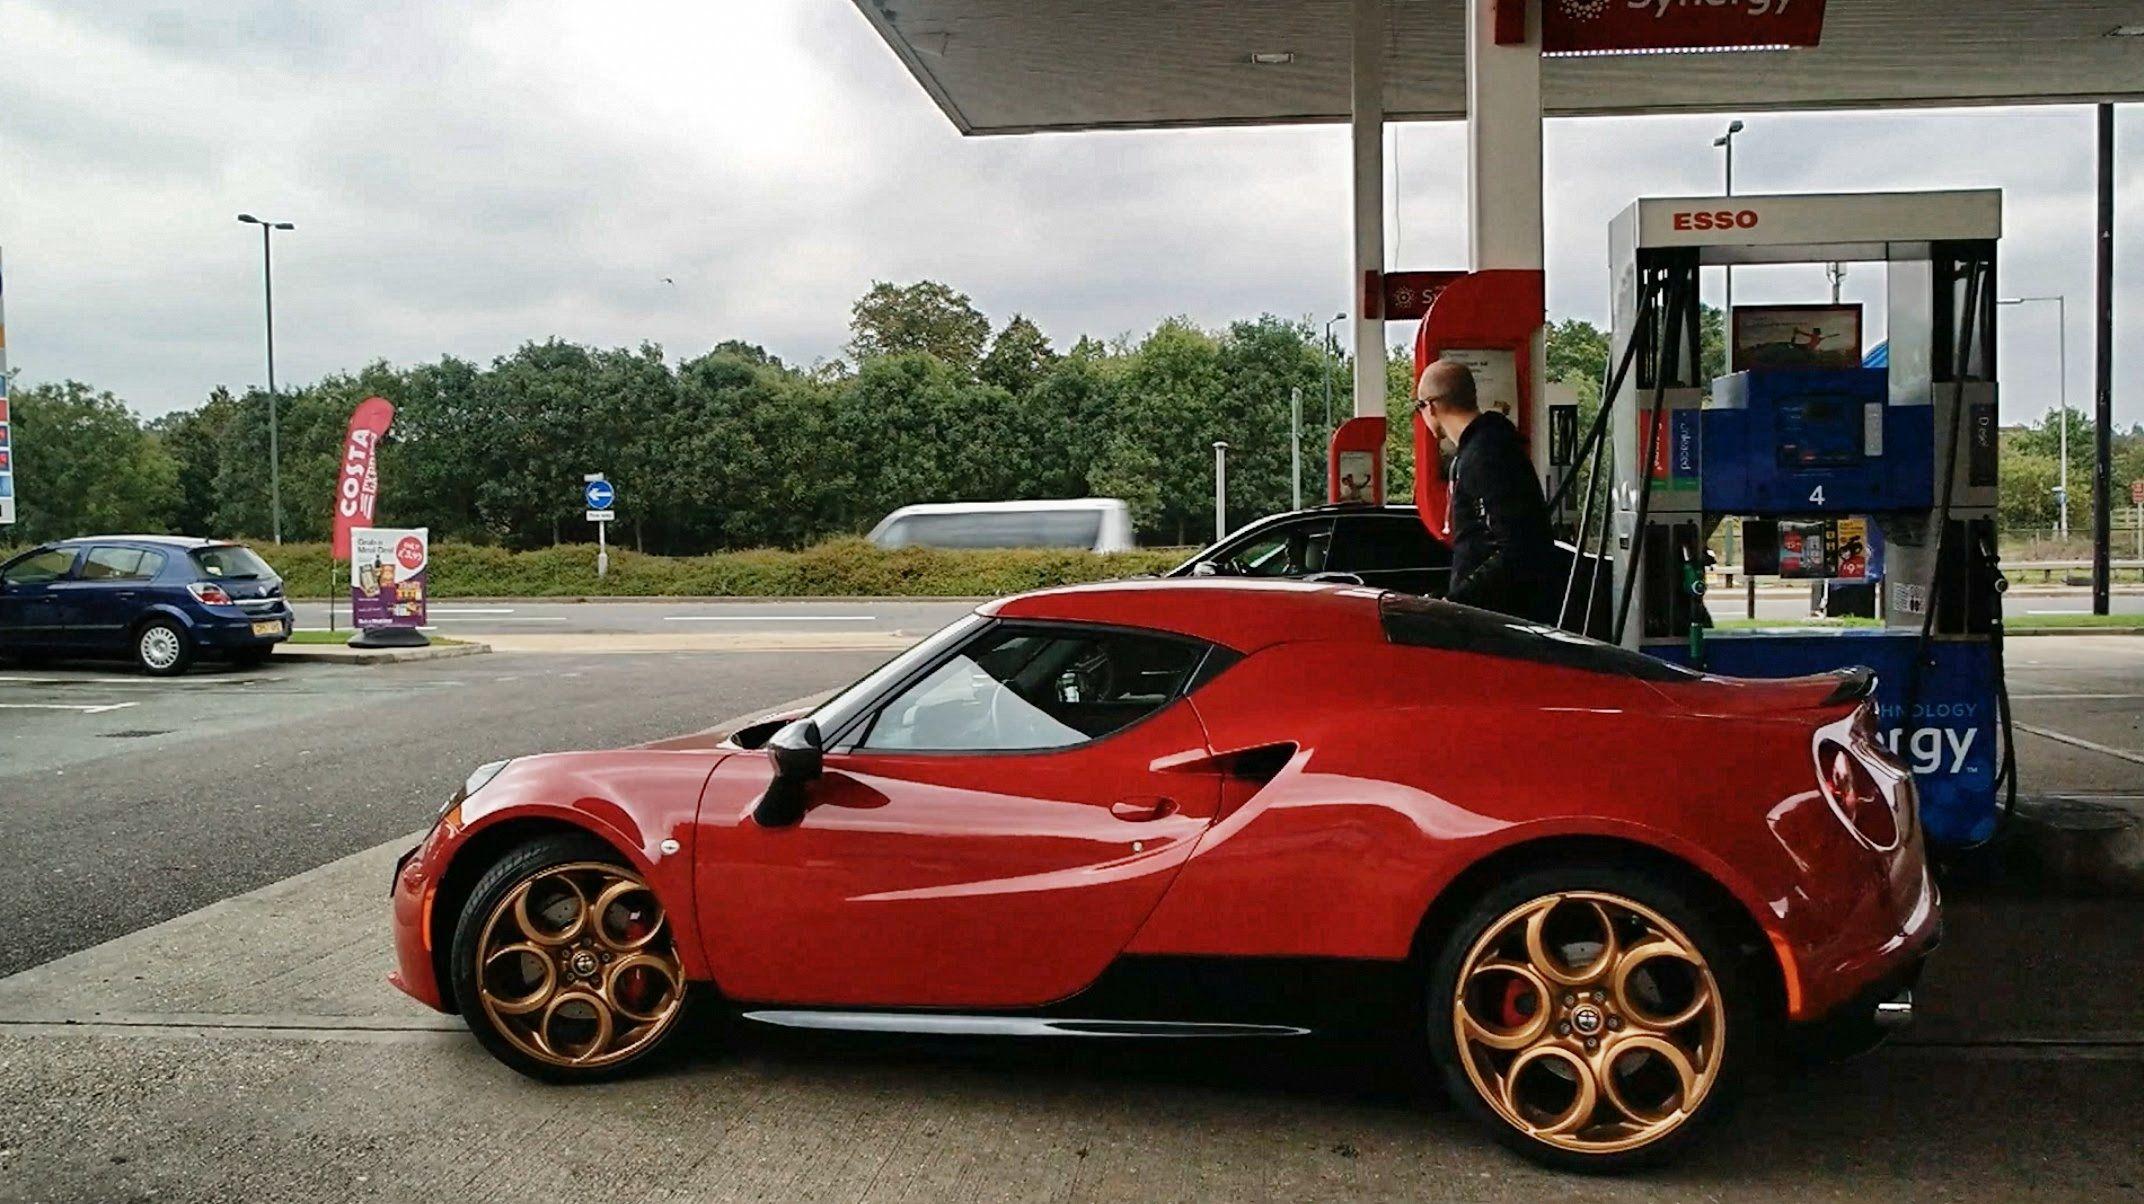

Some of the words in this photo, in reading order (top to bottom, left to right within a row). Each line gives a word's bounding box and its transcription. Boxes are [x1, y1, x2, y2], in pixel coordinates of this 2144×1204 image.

[1673, 210, 1758, 231] ESSO
[340, 428, 371, 518] COSTA
[1808, 485, 1826, 506] 4
